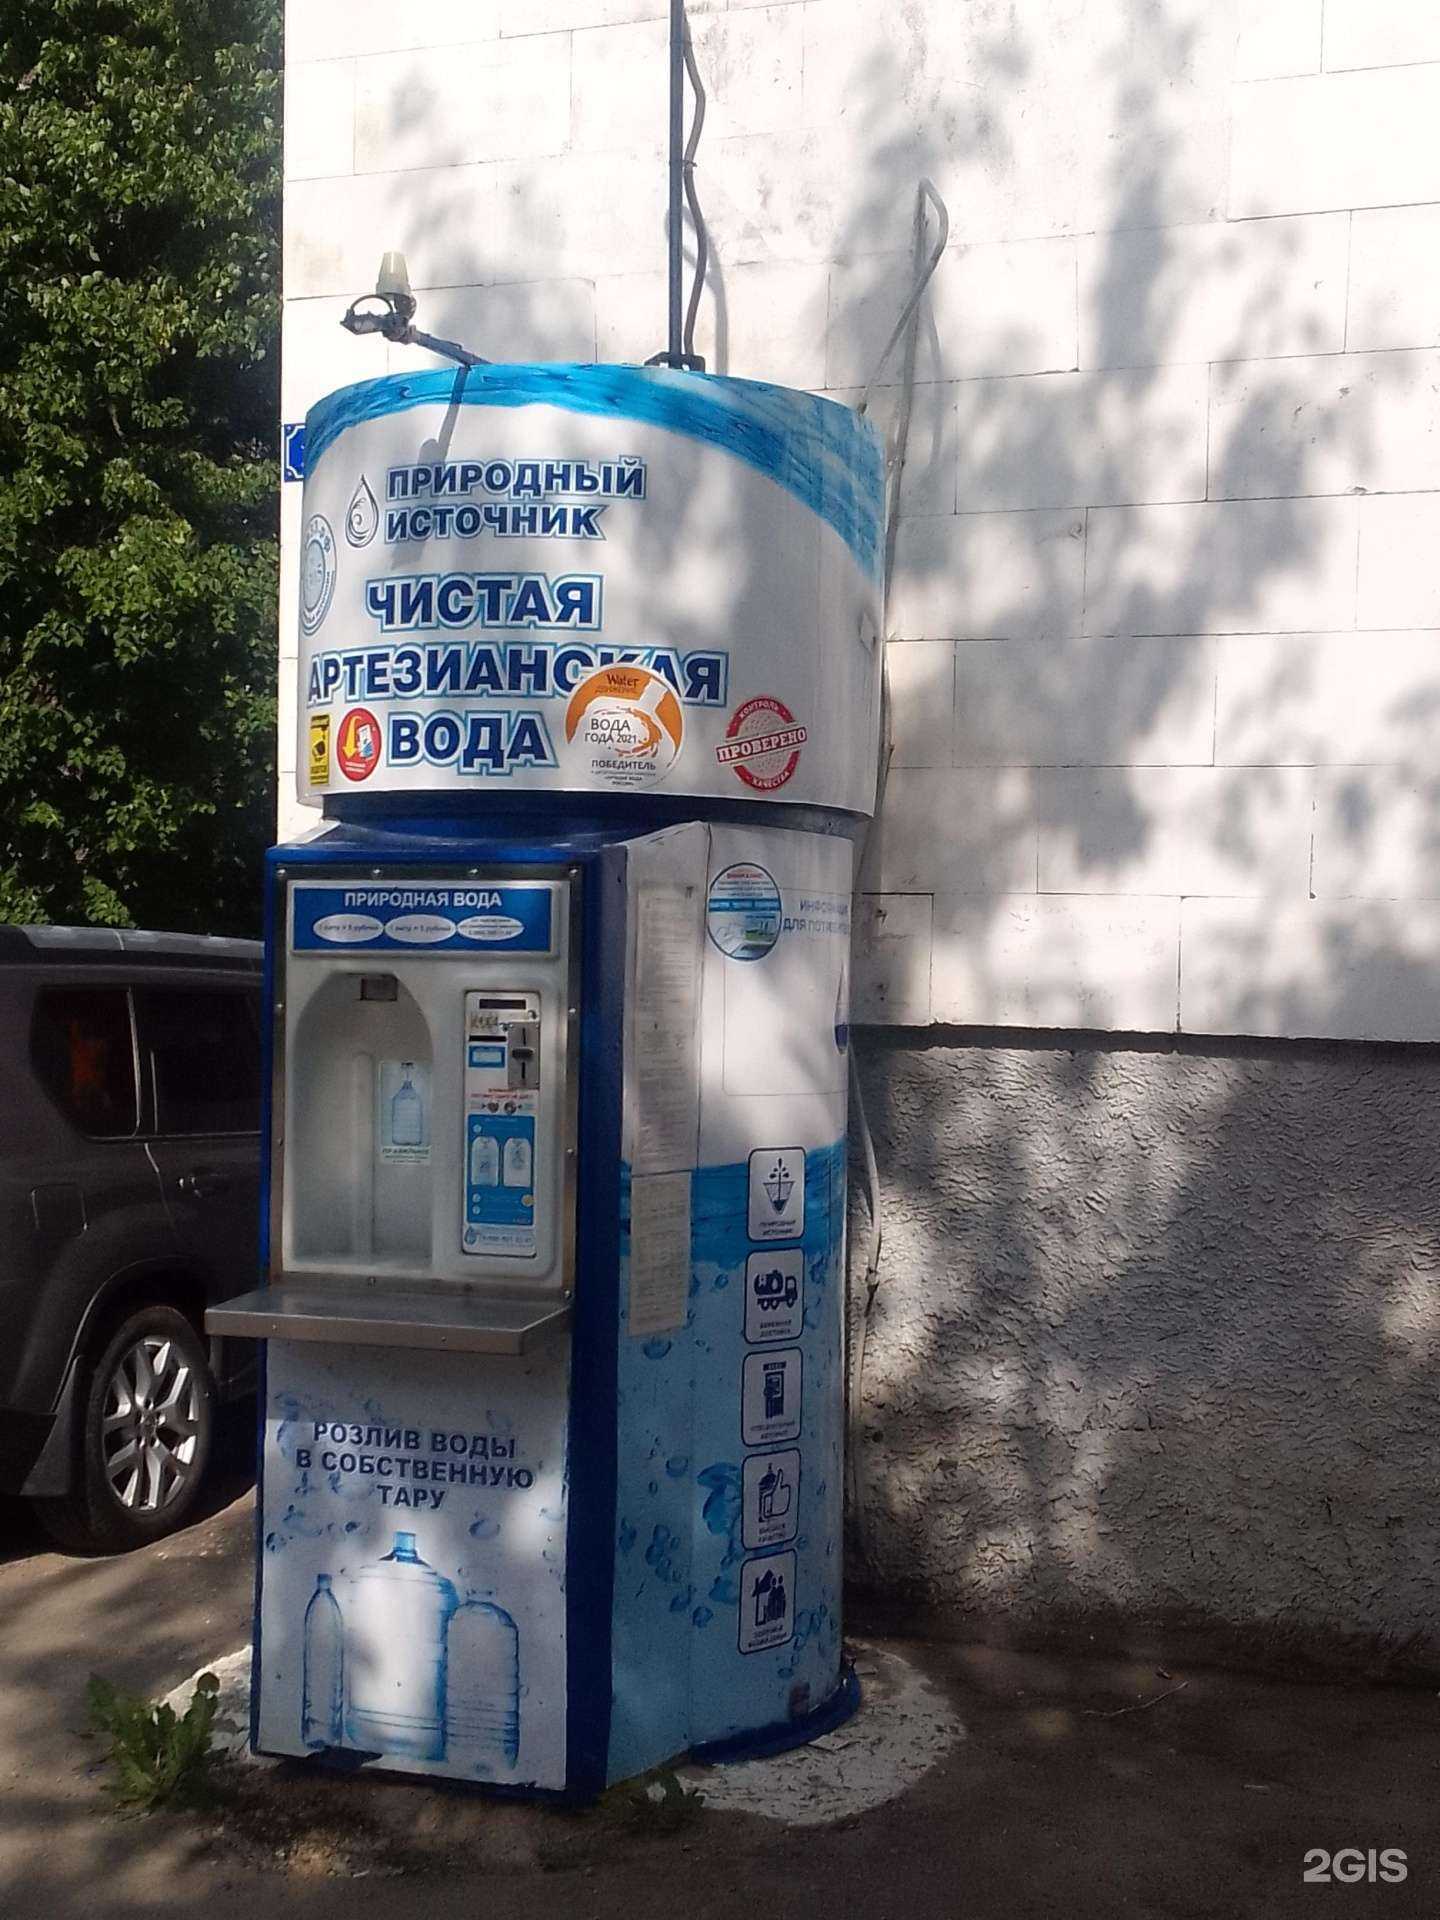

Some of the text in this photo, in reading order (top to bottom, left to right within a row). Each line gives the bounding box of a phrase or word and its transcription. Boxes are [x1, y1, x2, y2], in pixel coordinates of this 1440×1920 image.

[386, 457, 646, 498] ПРИРОДНЫЙ
[386, 503, 603, 542] ИСТОЧНИК
[366, 576, 598, 629] ЧИСТАЯ
[309, 645, 724, 704] АРТЕЗИАНСАЯ
[389, 714, 553, 772] ВОДА
[585, 732, 637, 744] ГОДА 2021
[591, 718, 631, 734] ВОДА
[718, 729, 806, 761] ПРОВЕРЕНО
[591, 760, 656, 770] ПОБЕДИТЕЛЬ
[344, 891, 502, 908] ПРИРОДНАЯ ВОДА
[313, 1421, 516, 1460] РОЗЛИВ ВОДЫ
[296, 1448, 535, 1489] В СОБСТВЕННУЮ
[376, 1483, 446, 1510] ТАРУ
